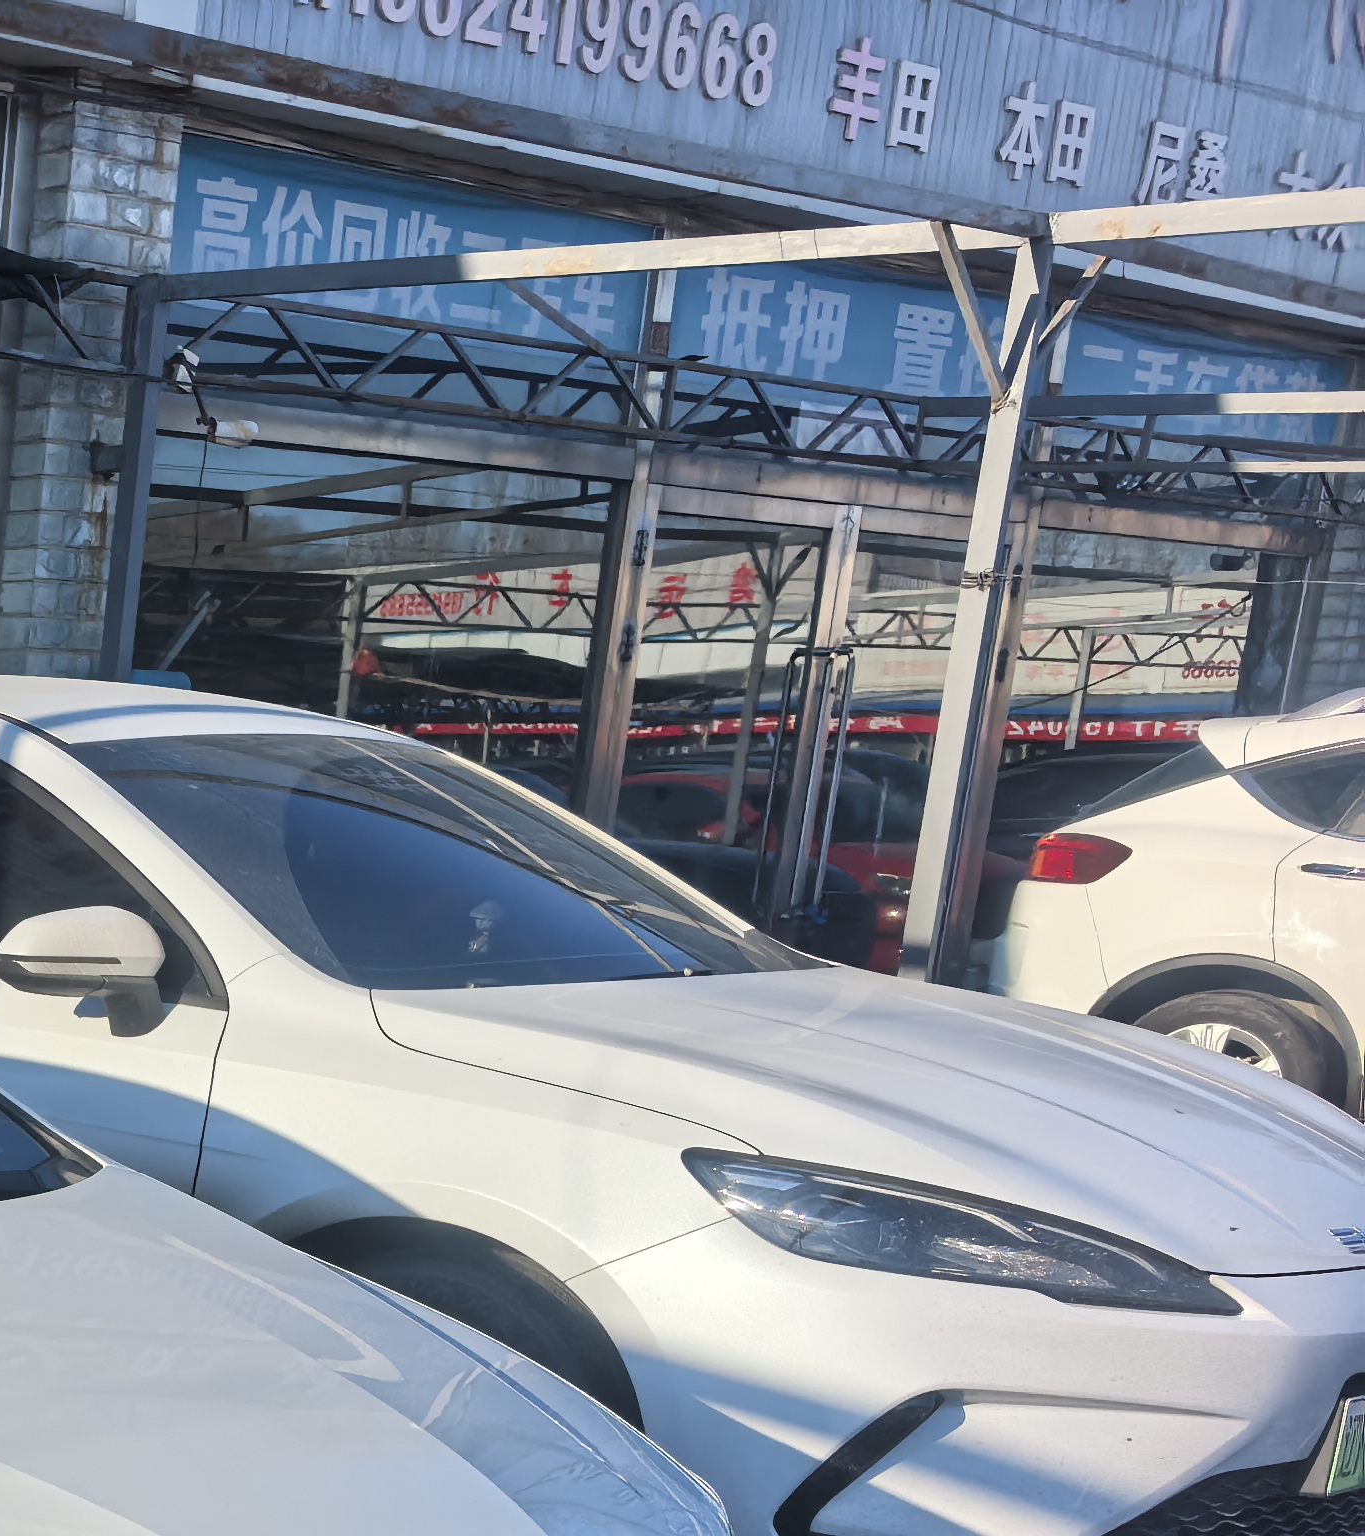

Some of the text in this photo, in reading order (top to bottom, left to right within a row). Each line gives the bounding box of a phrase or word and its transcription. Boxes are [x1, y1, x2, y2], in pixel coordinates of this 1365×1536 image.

[349, 0, 777, 107] 24199668
[828, 37, 940, 154] 丰田
[999, 80, 1096, 188] 本田
[701, 267, 851, 382] 抵押
